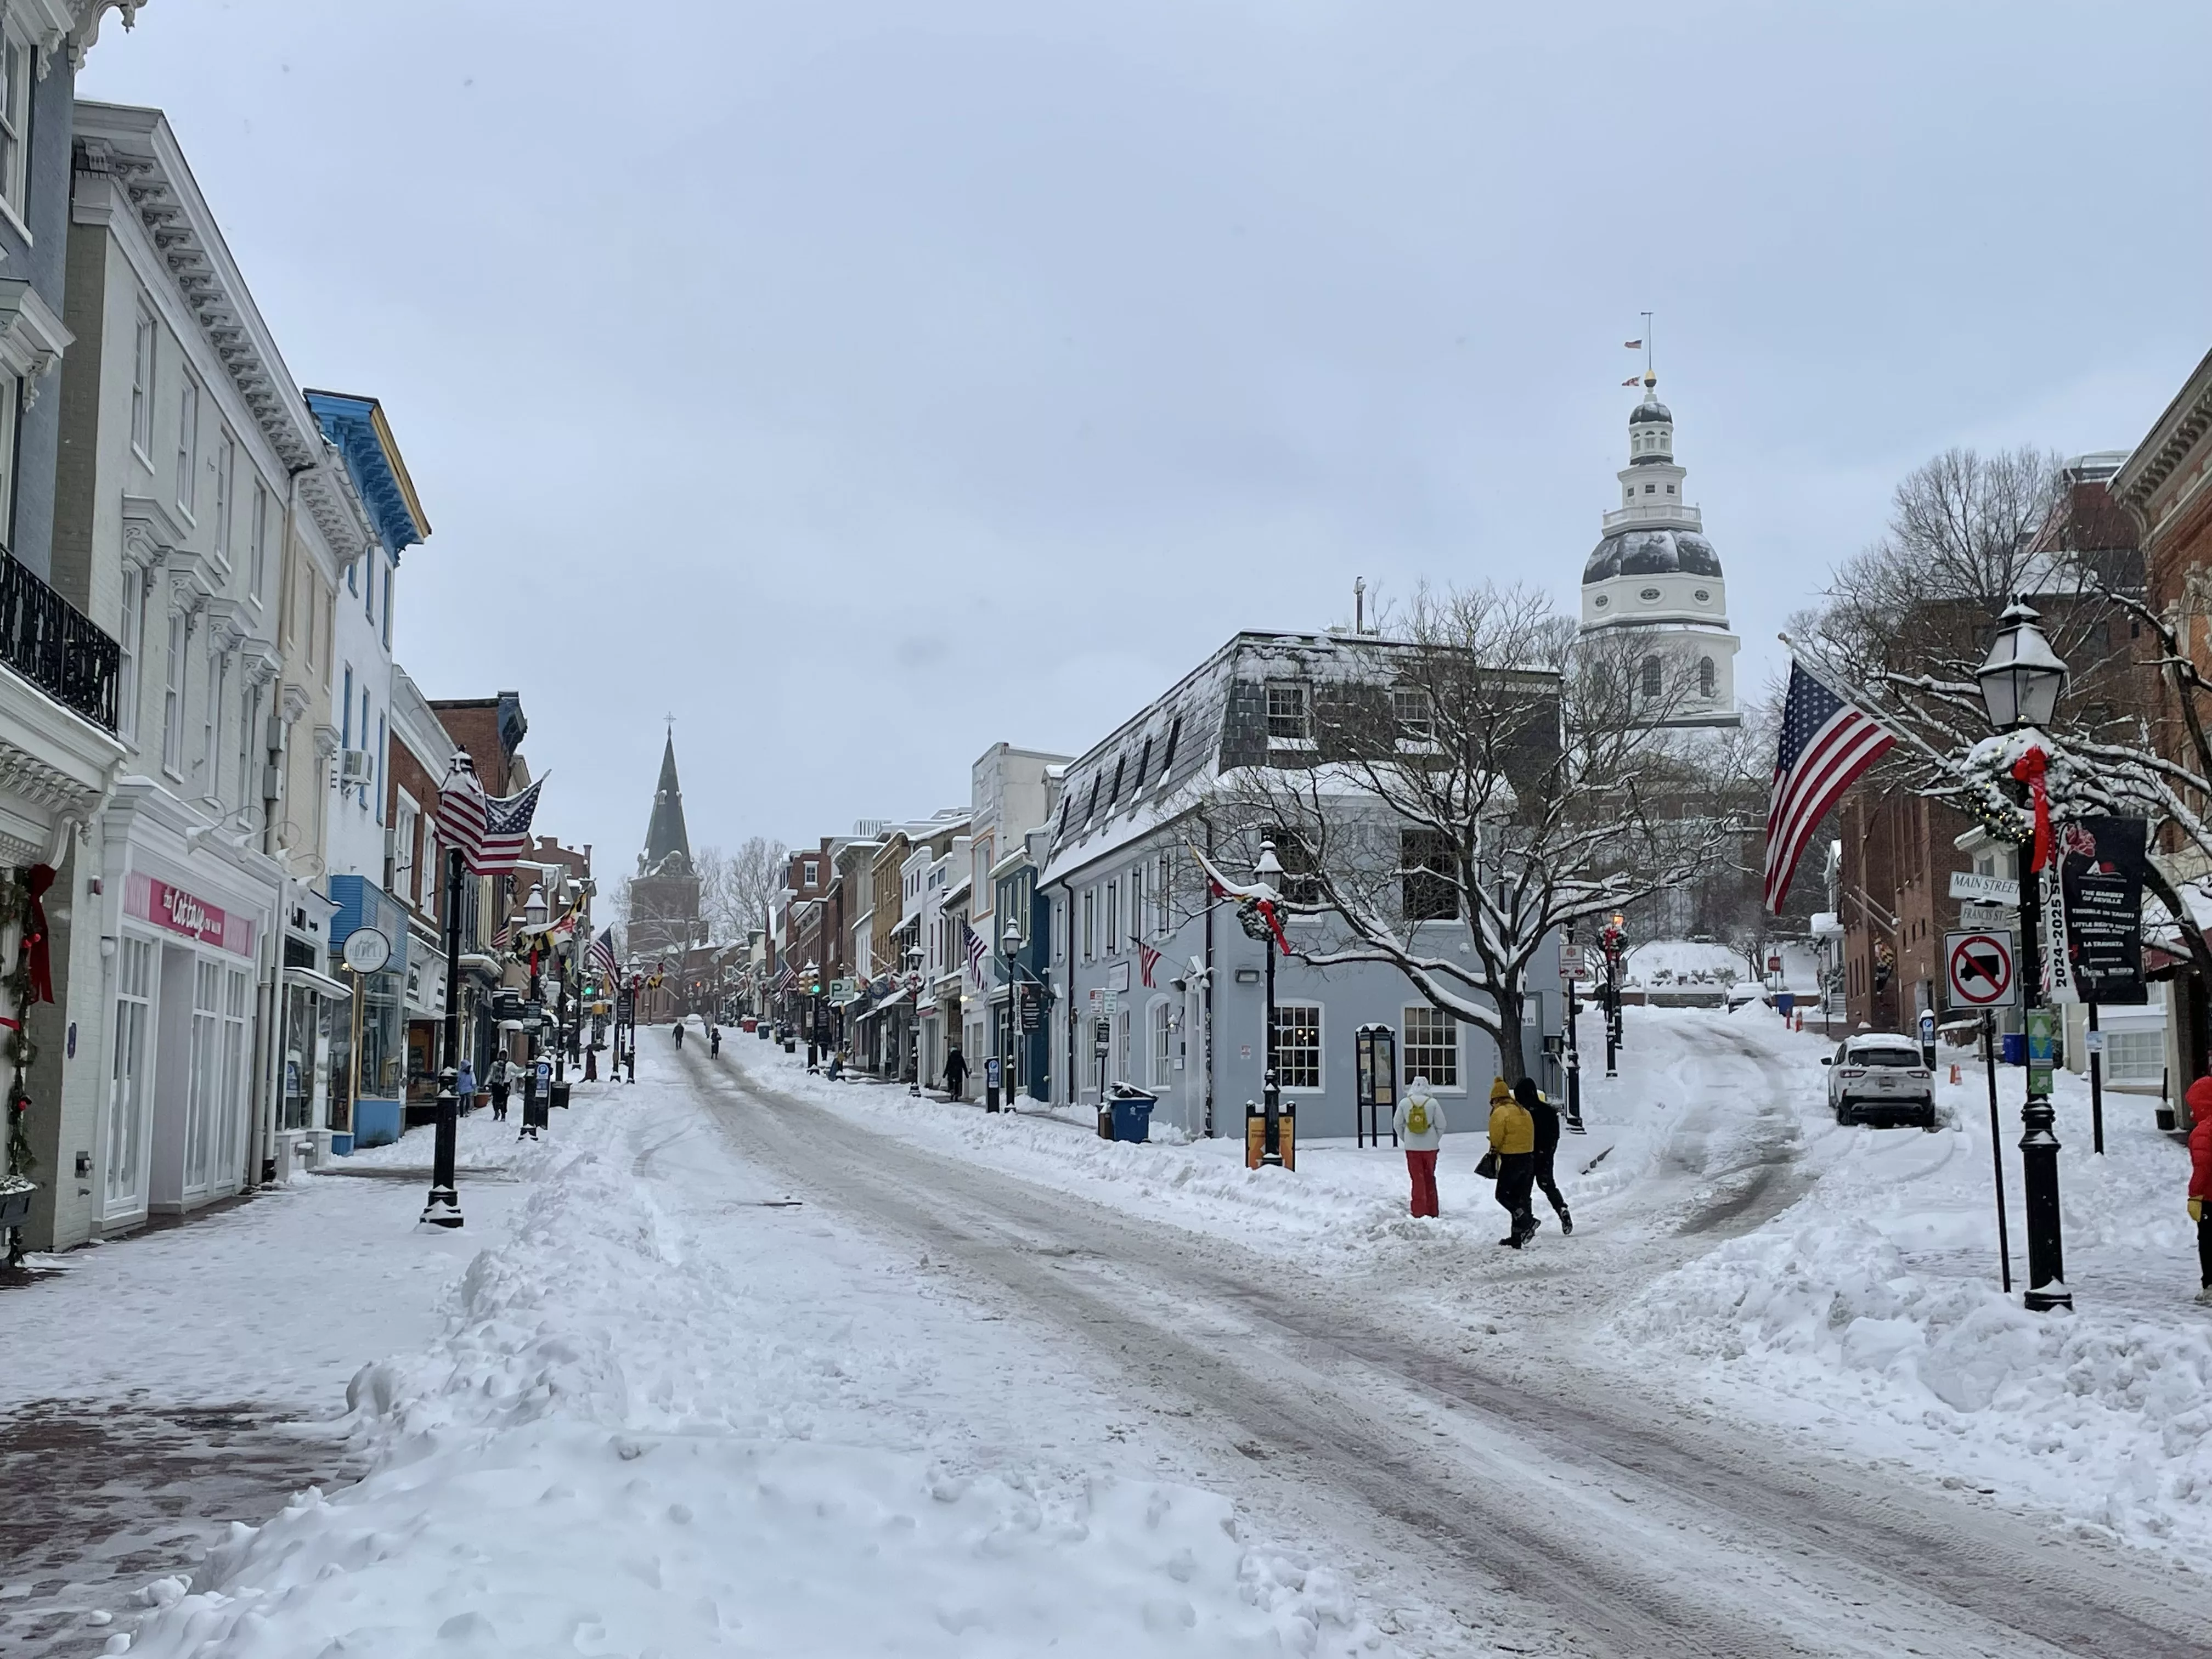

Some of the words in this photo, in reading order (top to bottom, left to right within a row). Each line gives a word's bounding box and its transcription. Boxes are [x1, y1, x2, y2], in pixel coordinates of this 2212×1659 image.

[1954, 875, 1982, 888] MAIN
[1983, 879, 2019, 894] STREET
[1962, 907, 1994, 920] FRANCIS
[1994, 911, 2006, 921] ST.
[2050, 899, 2068, 988] 2024-2025
[832, 983, 843, 997] P
